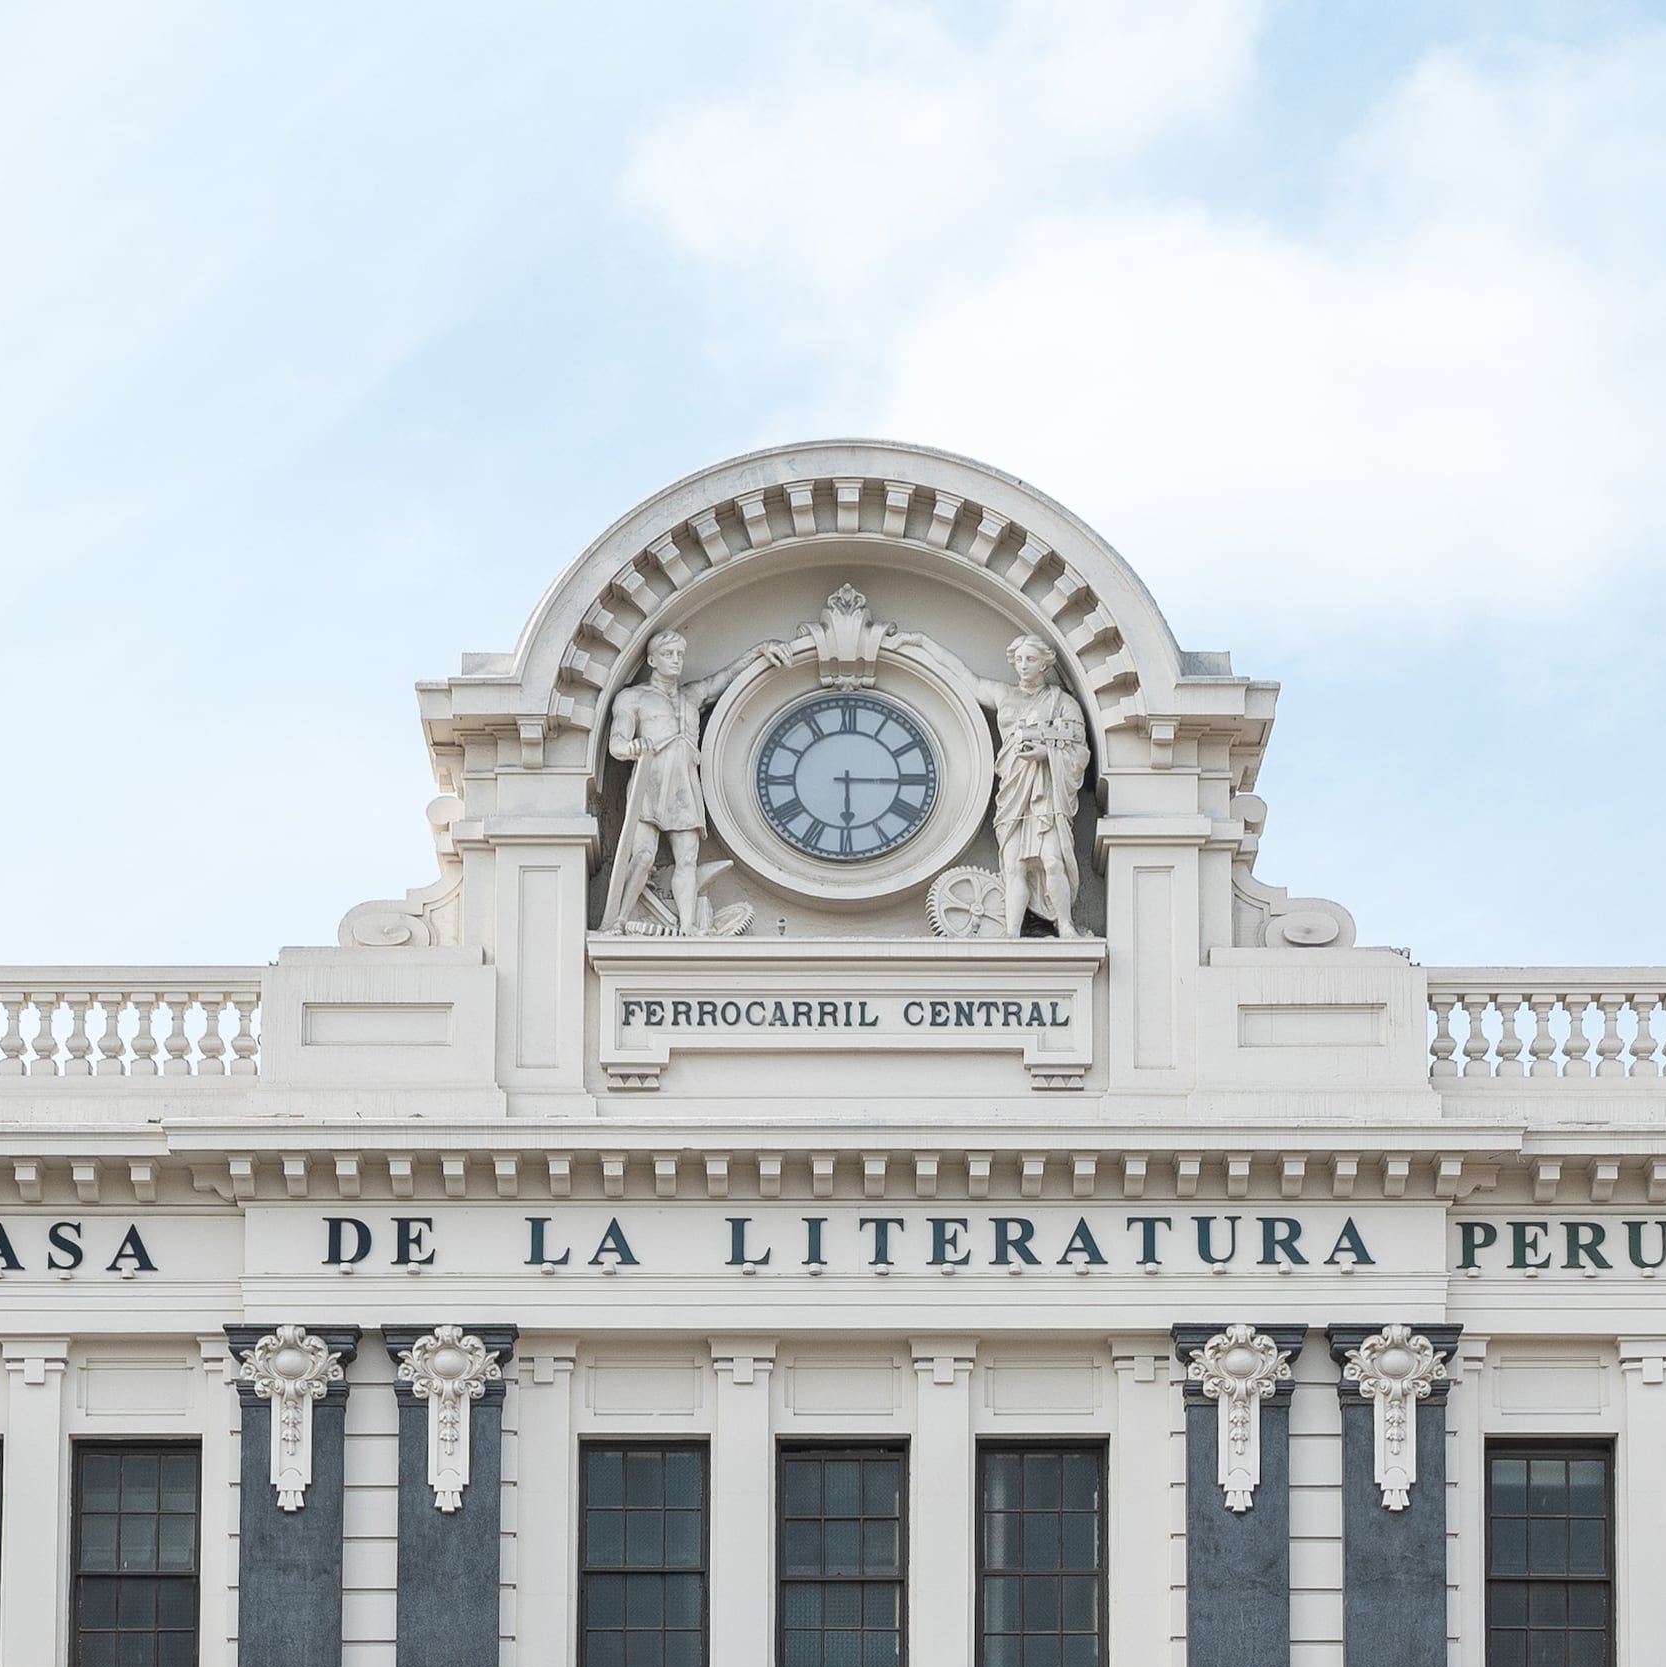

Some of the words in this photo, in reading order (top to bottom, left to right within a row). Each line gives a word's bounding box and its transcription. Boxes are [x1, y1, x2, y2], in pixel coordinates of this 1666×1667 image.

[622, 1001, 879, 1027] FERROCARRIL
[903, 1001, 1070, 1027] CENTRAL
[321, 1217, 436, 1266] DE
[524, 1217, 641, 1266] LA
[724, 1215, 1376, 1266] LITERATURA
